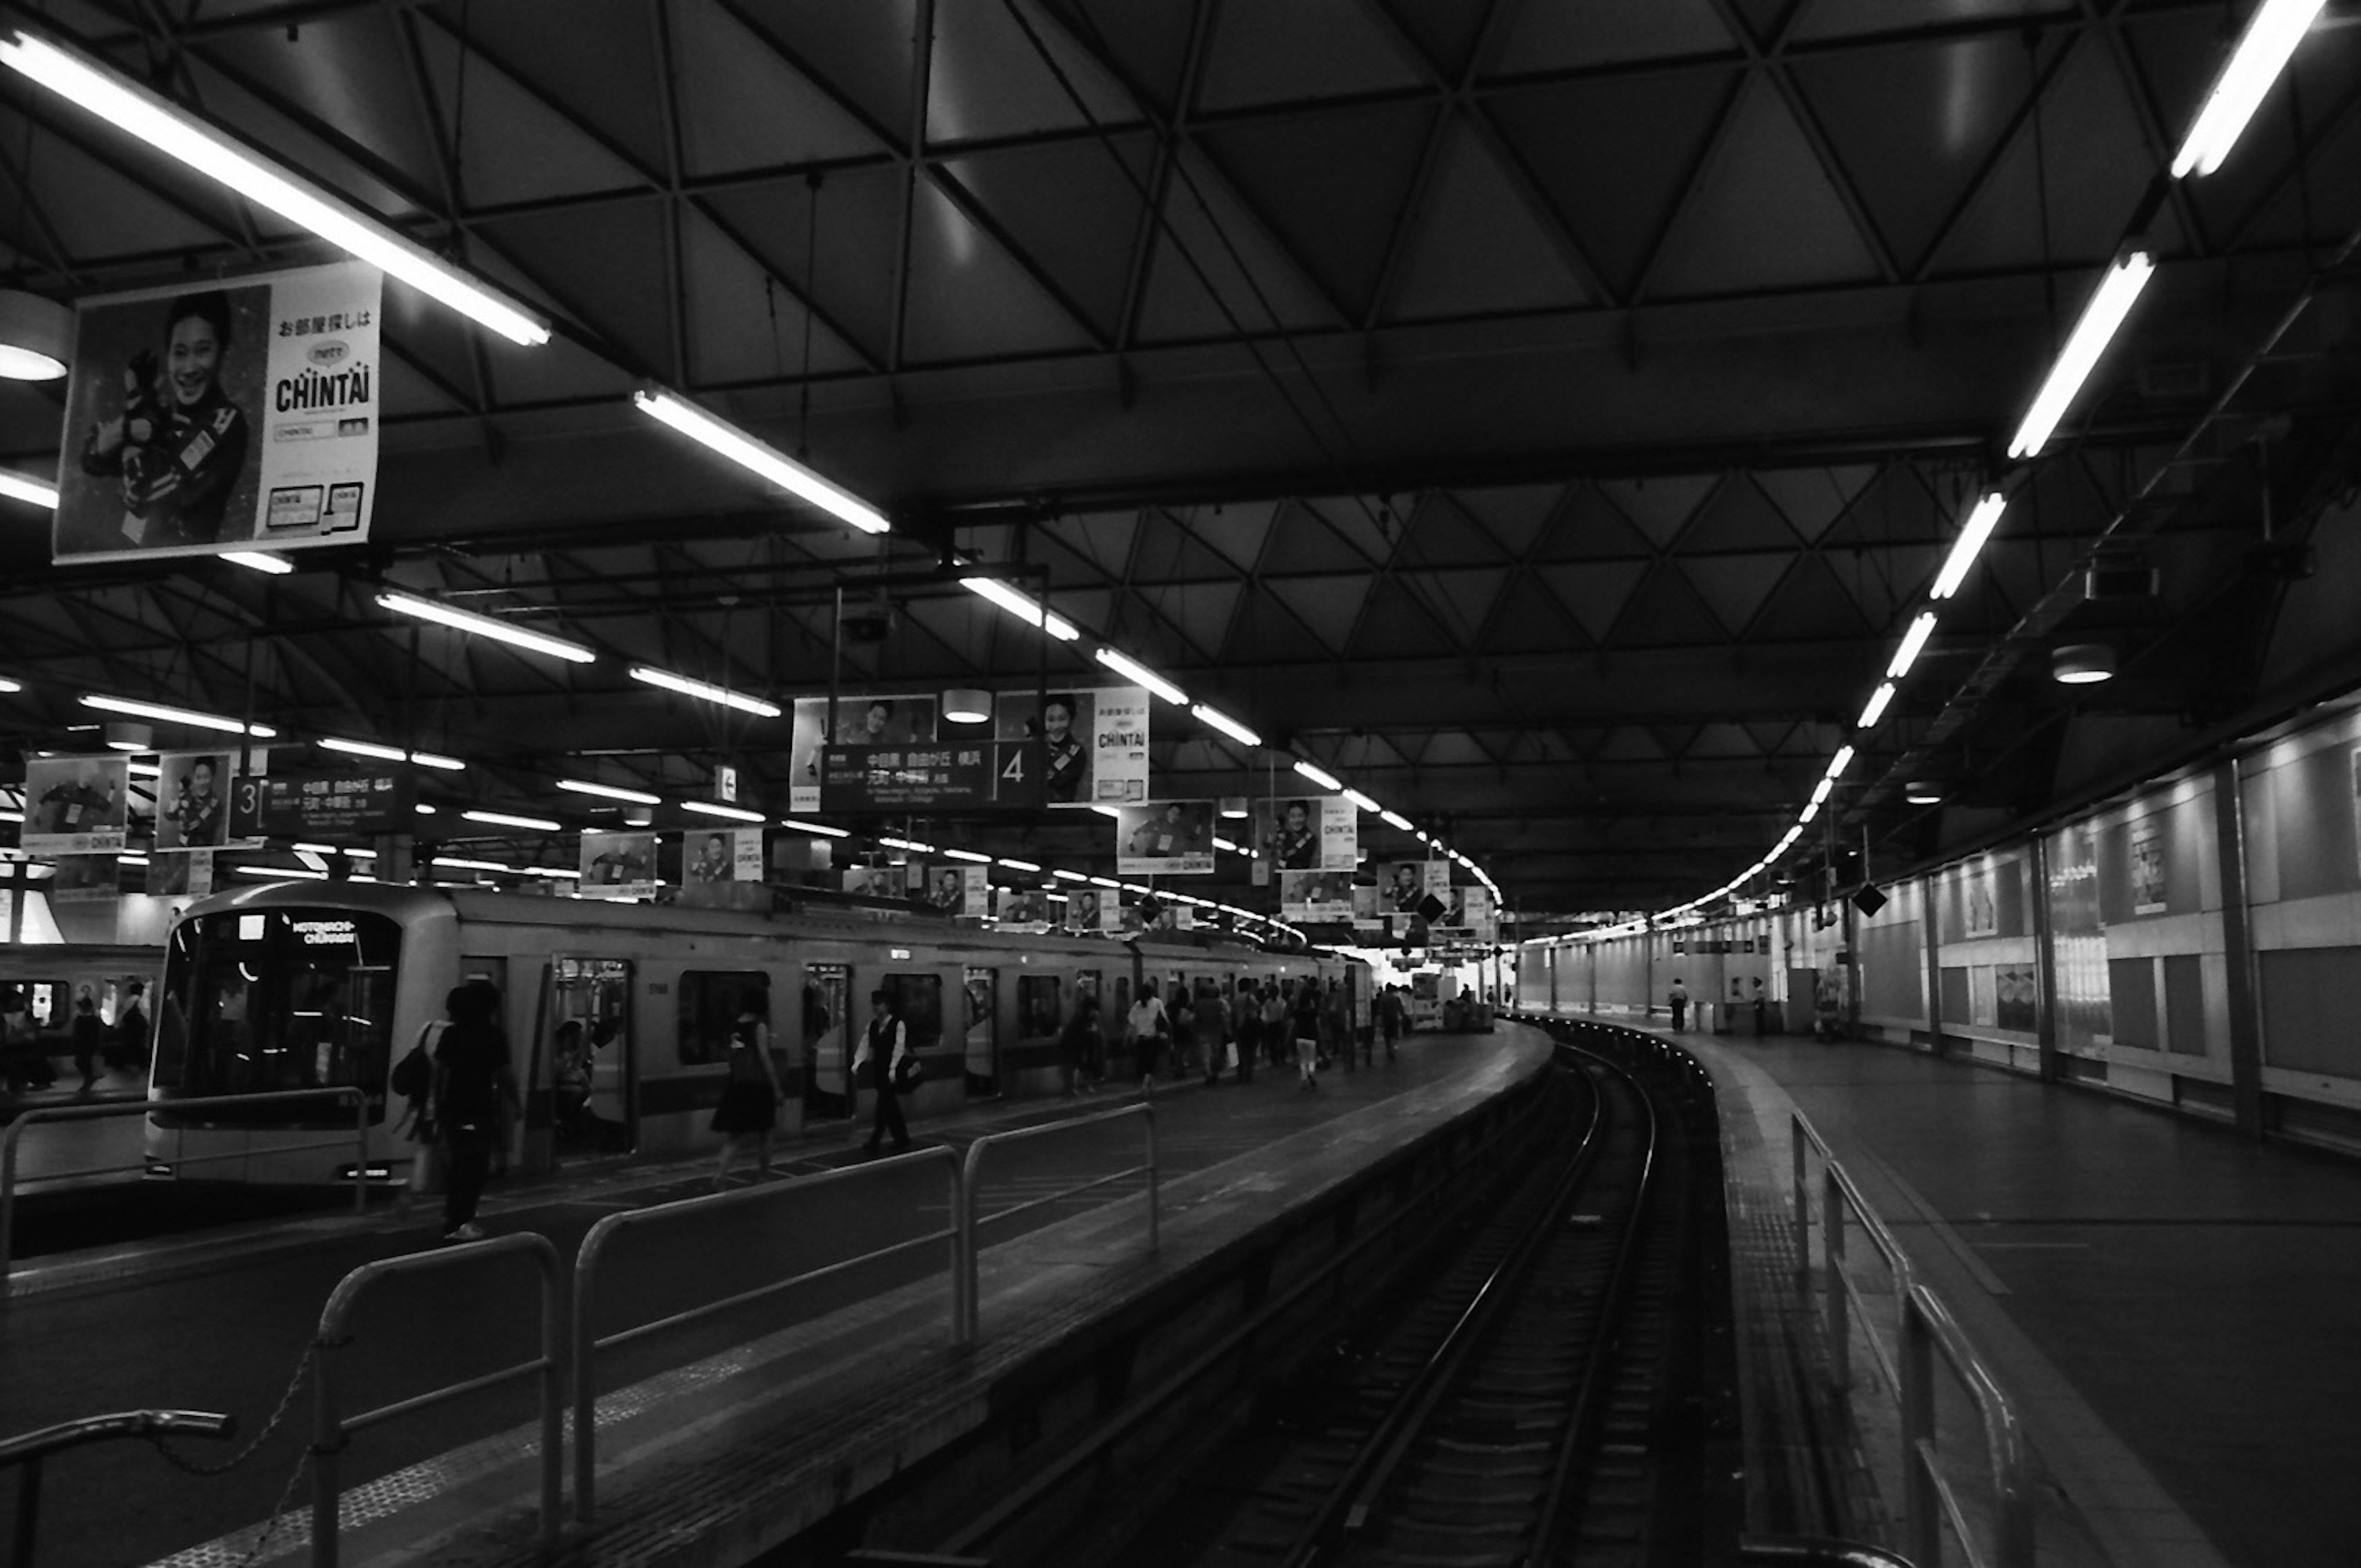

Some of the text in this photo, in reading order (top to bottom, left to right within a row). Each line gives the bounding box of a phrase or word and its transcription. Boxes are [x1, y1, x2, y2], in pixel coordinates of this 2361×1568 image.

[276, 369, 369, 412] CHINTAI
[1099, 733, 1144, 748] CHINTAI
[1002, 749, 1024, 782] 4
[240, 784, 256, 814] 3
